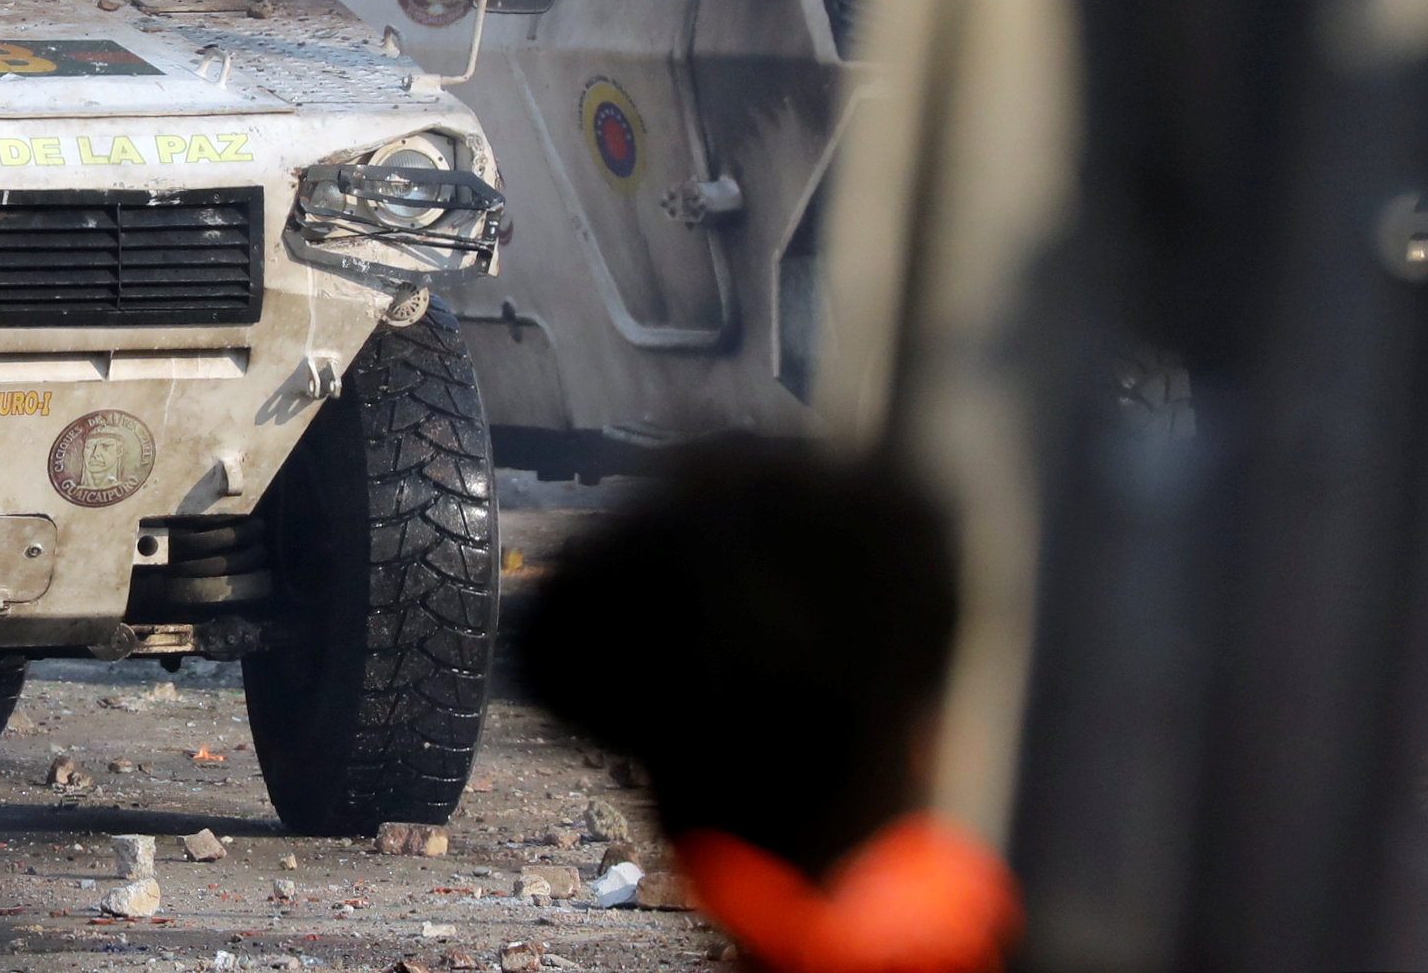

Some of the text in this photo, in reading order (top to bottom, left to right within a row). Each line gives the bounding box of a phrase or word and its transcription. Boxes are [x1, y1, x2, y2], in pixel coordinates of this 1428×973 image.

[76, 135, 147, 165] LA
[155, 133, 254, 164] PAZ
[54, 426, 83, 473] CACIQUES
[61, 476, 139, 503] GUAICAIPURO
